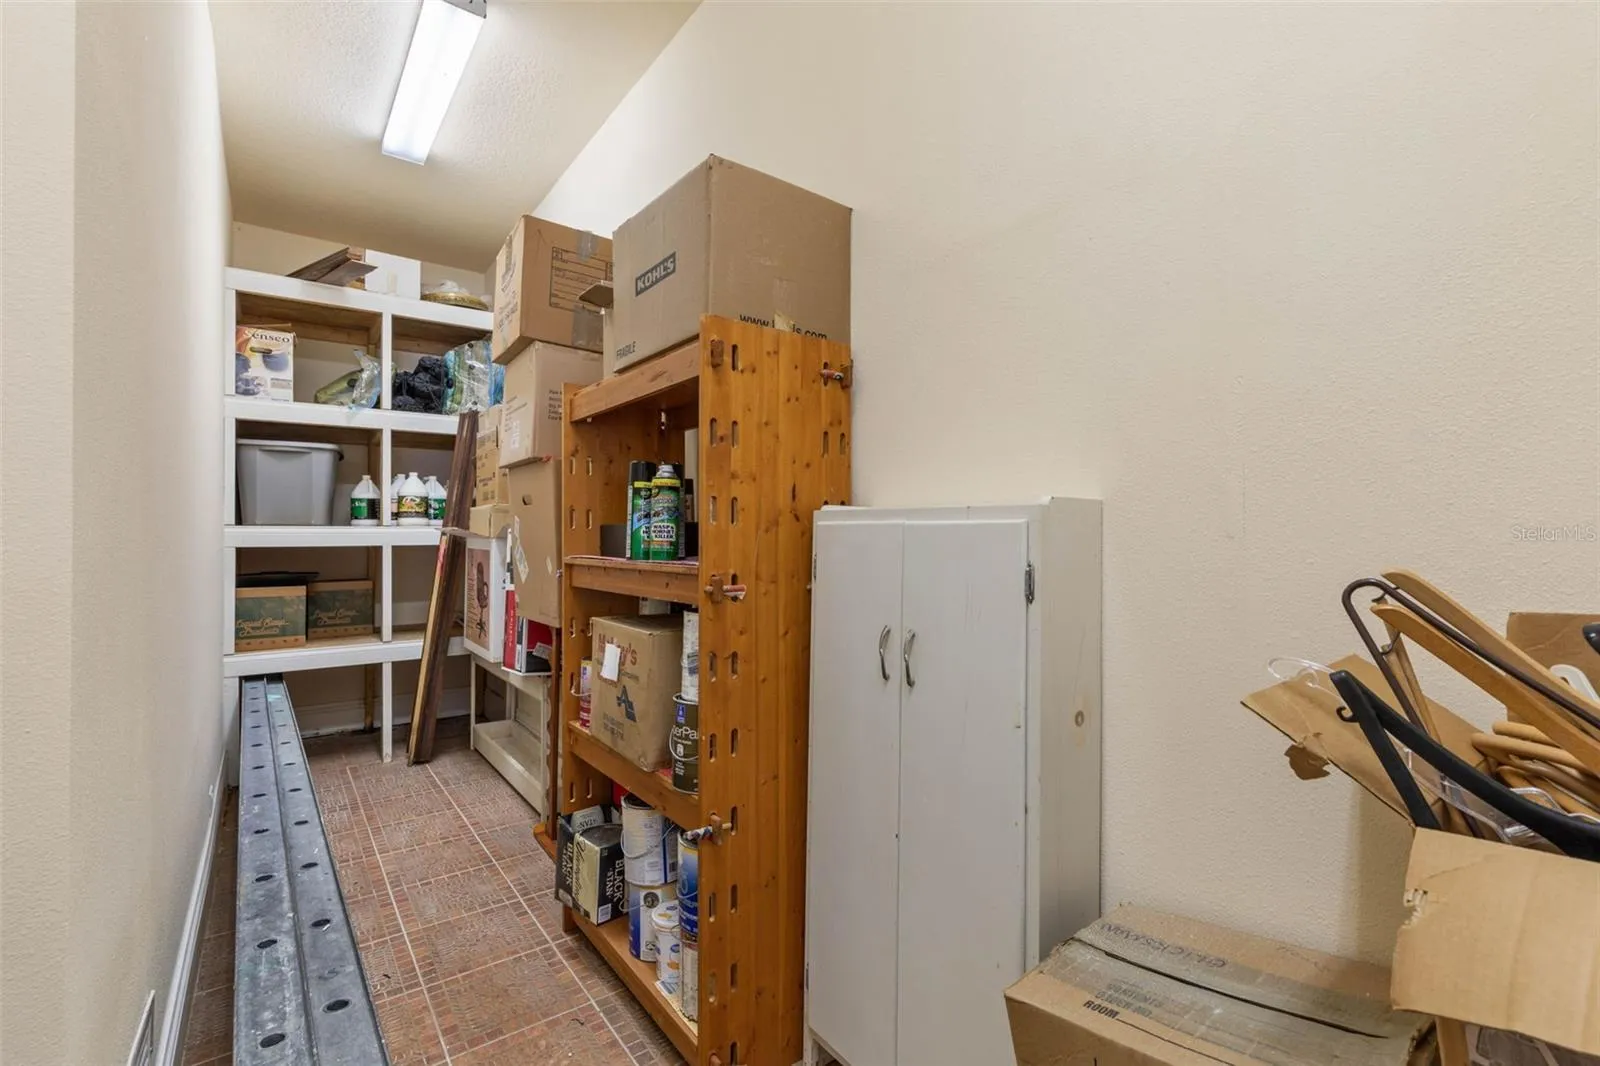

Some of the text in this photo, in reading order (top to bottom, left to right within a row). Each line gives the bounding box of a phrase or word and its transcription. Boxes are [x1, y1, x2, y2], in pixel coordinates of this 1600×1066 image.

[637, 257, 675, 292] KOHL'S
[613, 859, 625, 902] BLACK
[1083, 1000, 1120, 1019] ROOM
